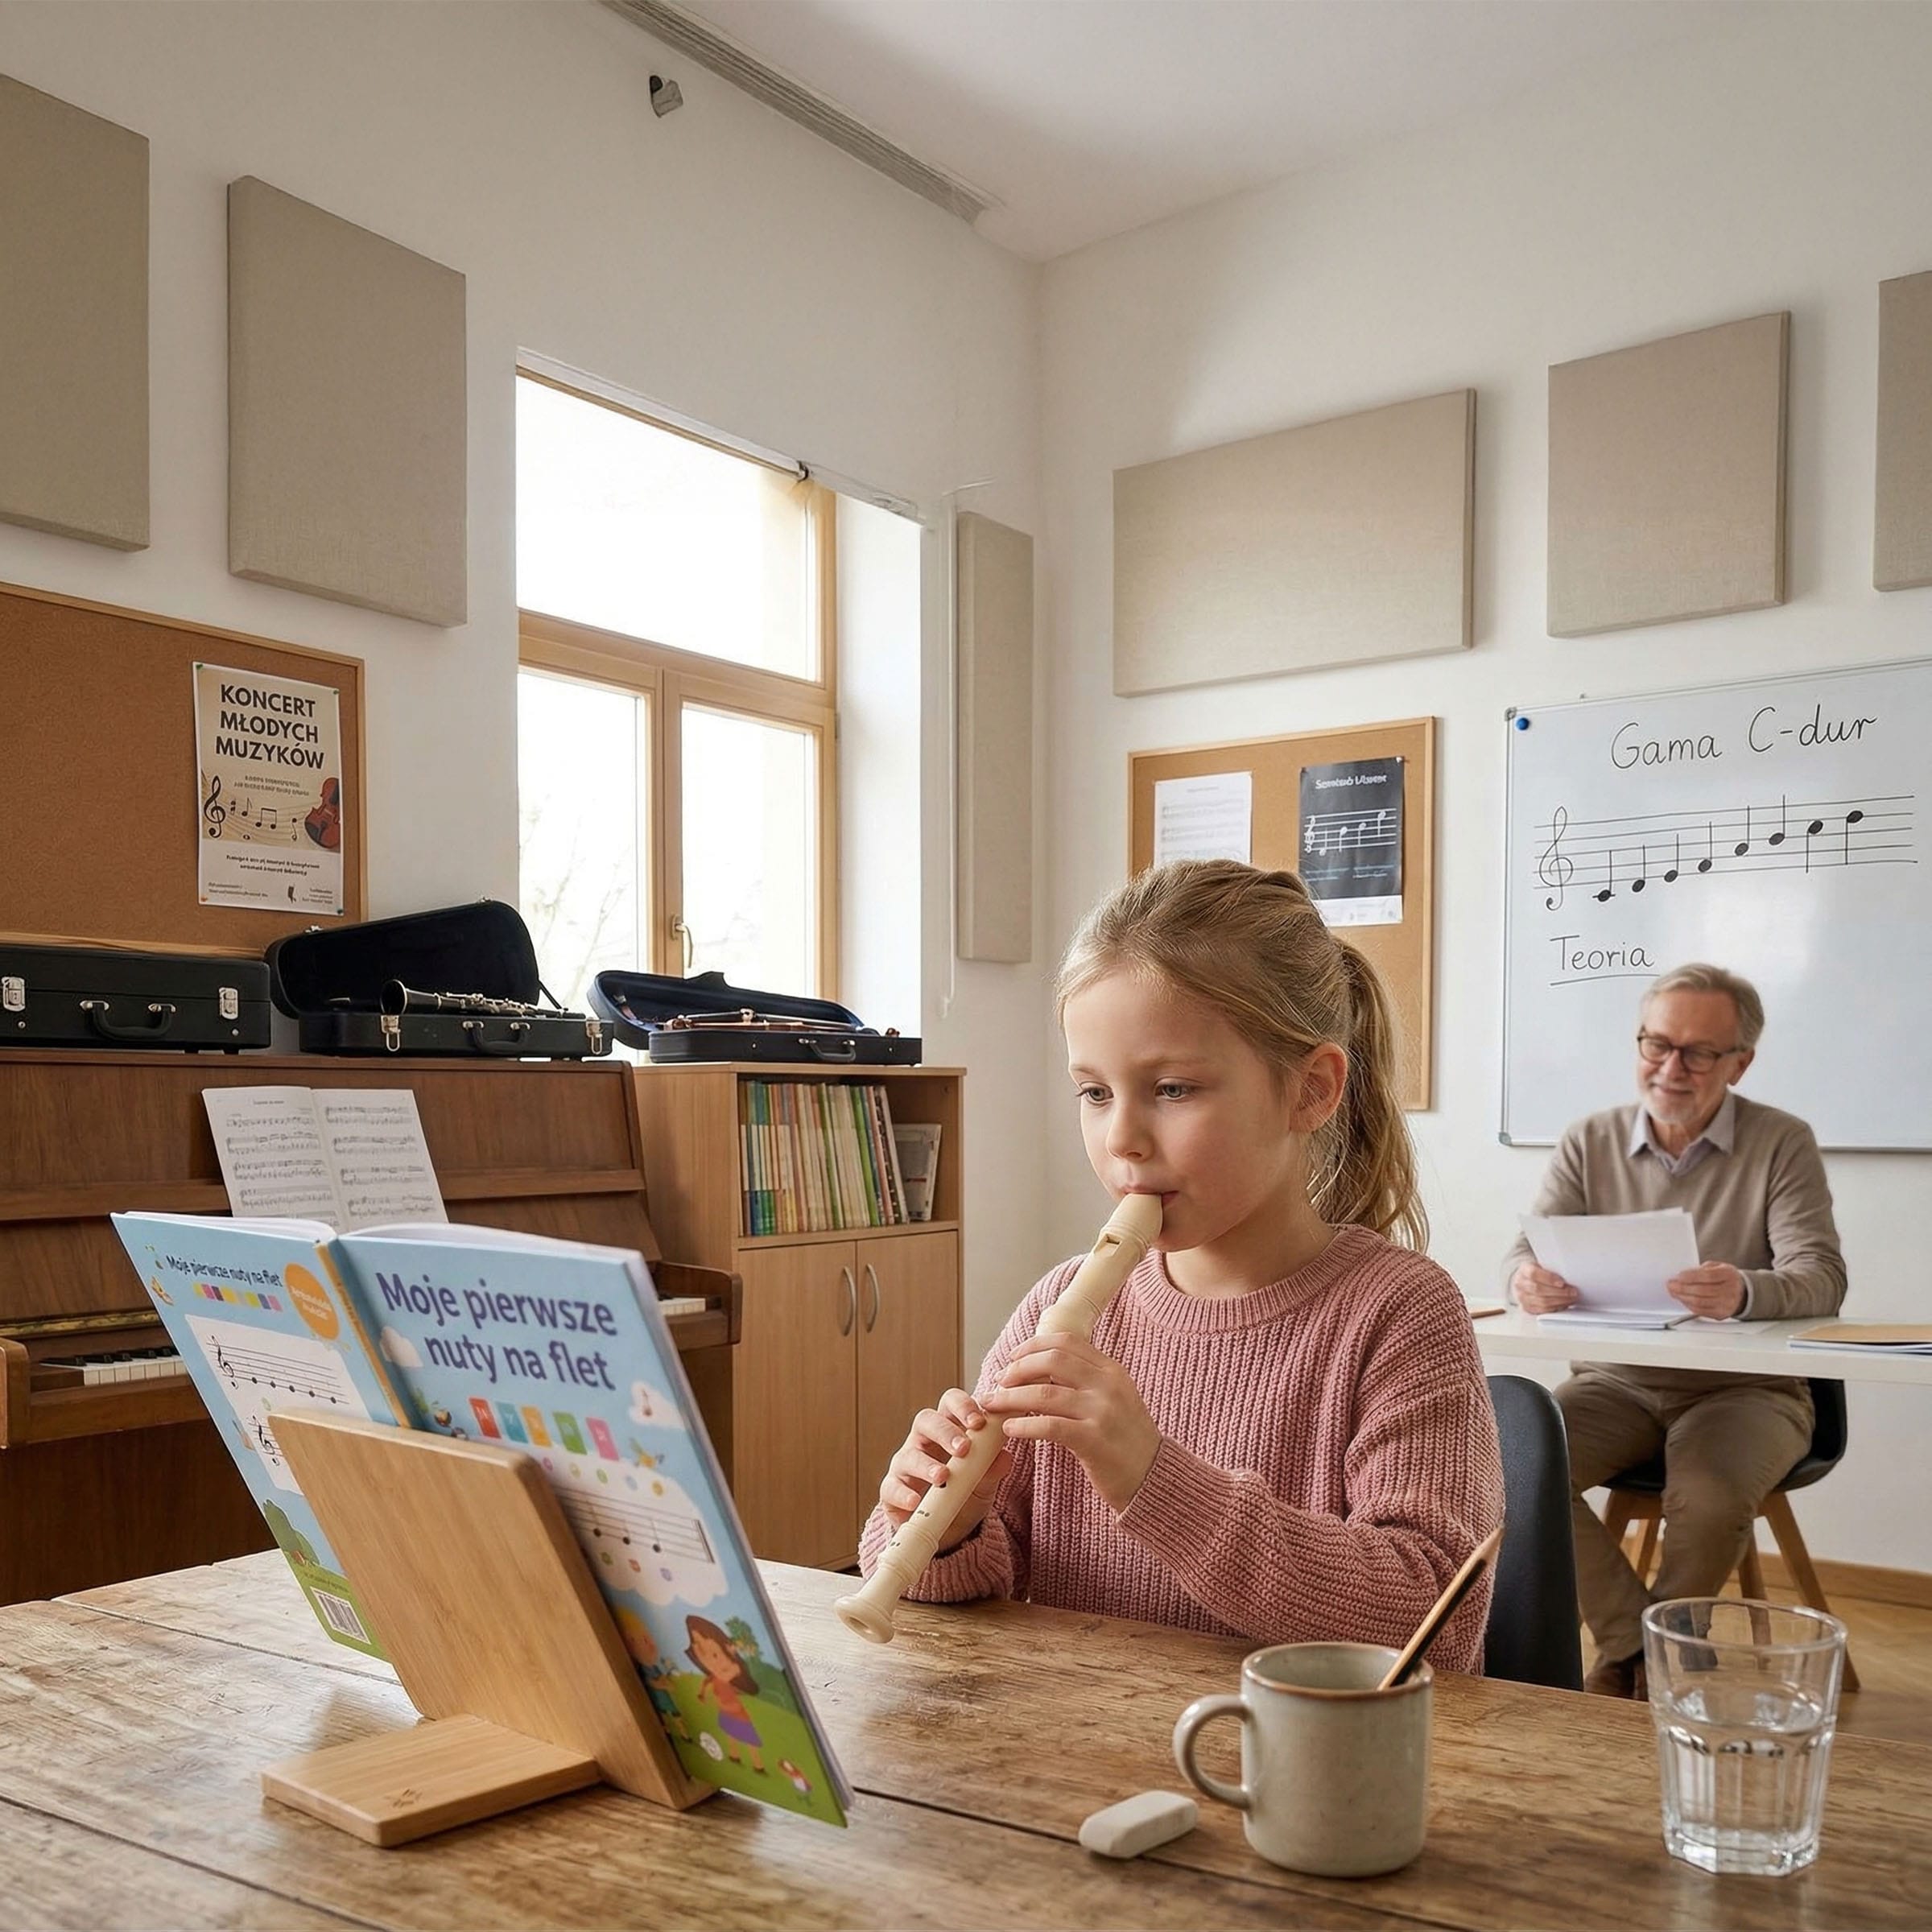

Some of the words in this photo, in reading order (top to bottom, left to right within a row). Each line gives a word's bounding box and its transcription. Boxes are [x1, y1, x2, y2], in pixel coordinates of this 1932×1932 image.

[221, 683, 316, 718] KONCERT
[220, 710, 318, 744] MŁODYCH
[1611, 722, 1722, 769] Gama
[1748, 704, 1877, 752] C-dur
[216, 736, 324, 770] MUZYKÓW
[1550, 935, 1655, 970] Teoria
[376, 1272, 461, 1327] Moje
[463, 1278, 618, 1336] pierwsze
[424, 1334, 497, 1384] nuty
[502, 1346, 547, 1380] na
[548, 1340, 617, 1391] flet
